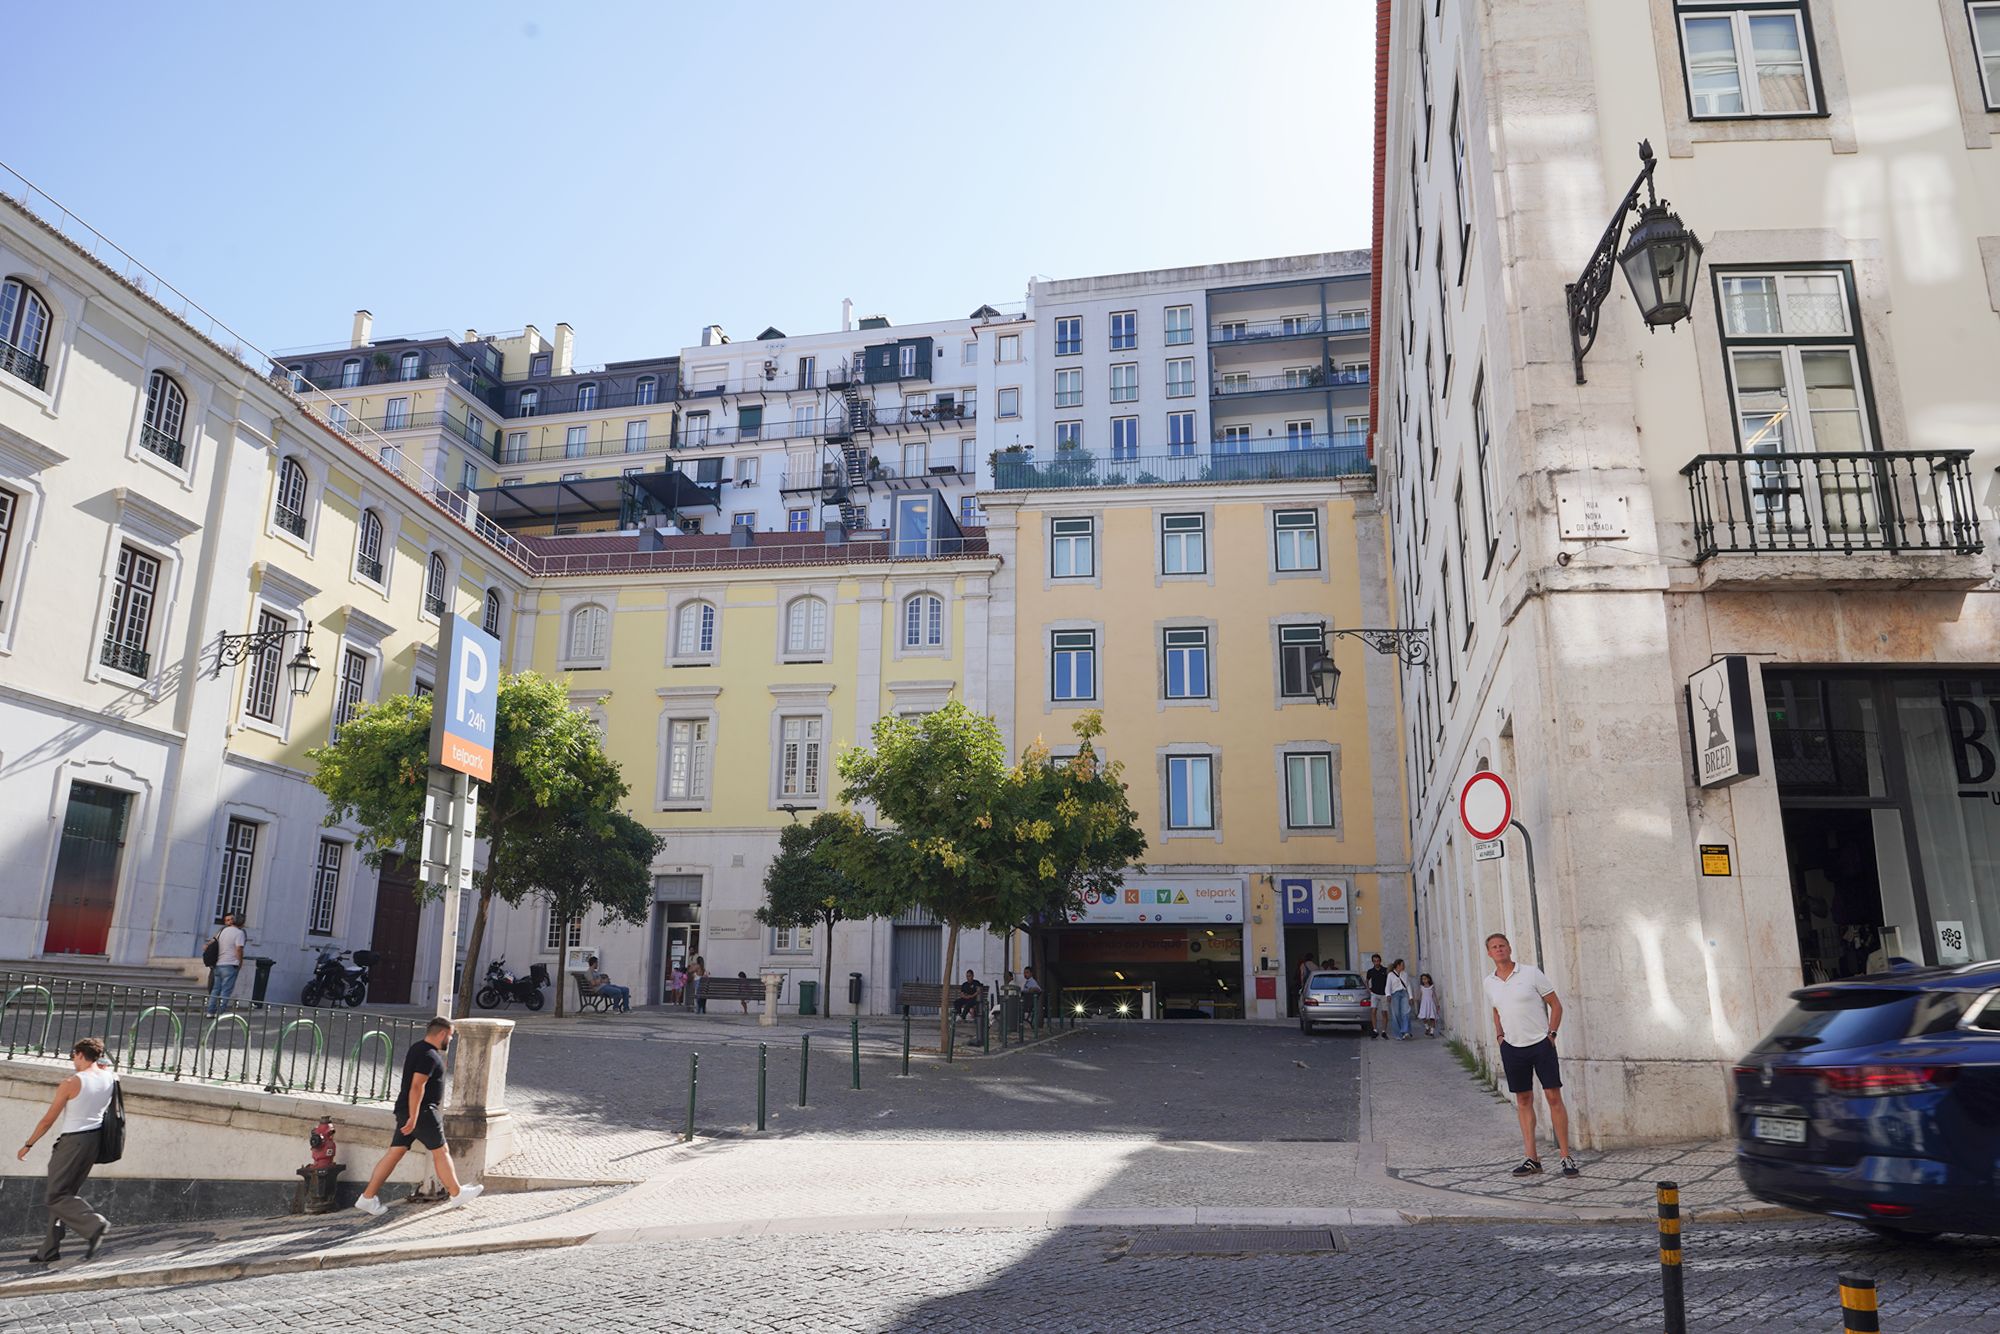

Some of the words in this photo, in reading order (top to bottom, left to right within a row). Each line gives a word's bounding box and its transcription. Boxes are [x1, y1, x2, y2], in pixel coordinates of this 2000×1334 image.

[1587, 523, 1613, 531] ALMADA
[456, 636, 487, 722] P
[468, 708, 486, 733] 24h
[452, 744, 484, 770] telpark
[1705, 745, 1731, 775] BREED
[104, 775, 113, 783] 14
[1196, 888, 1236, 899] telpark
[1287, 885, 1308, 914] P
